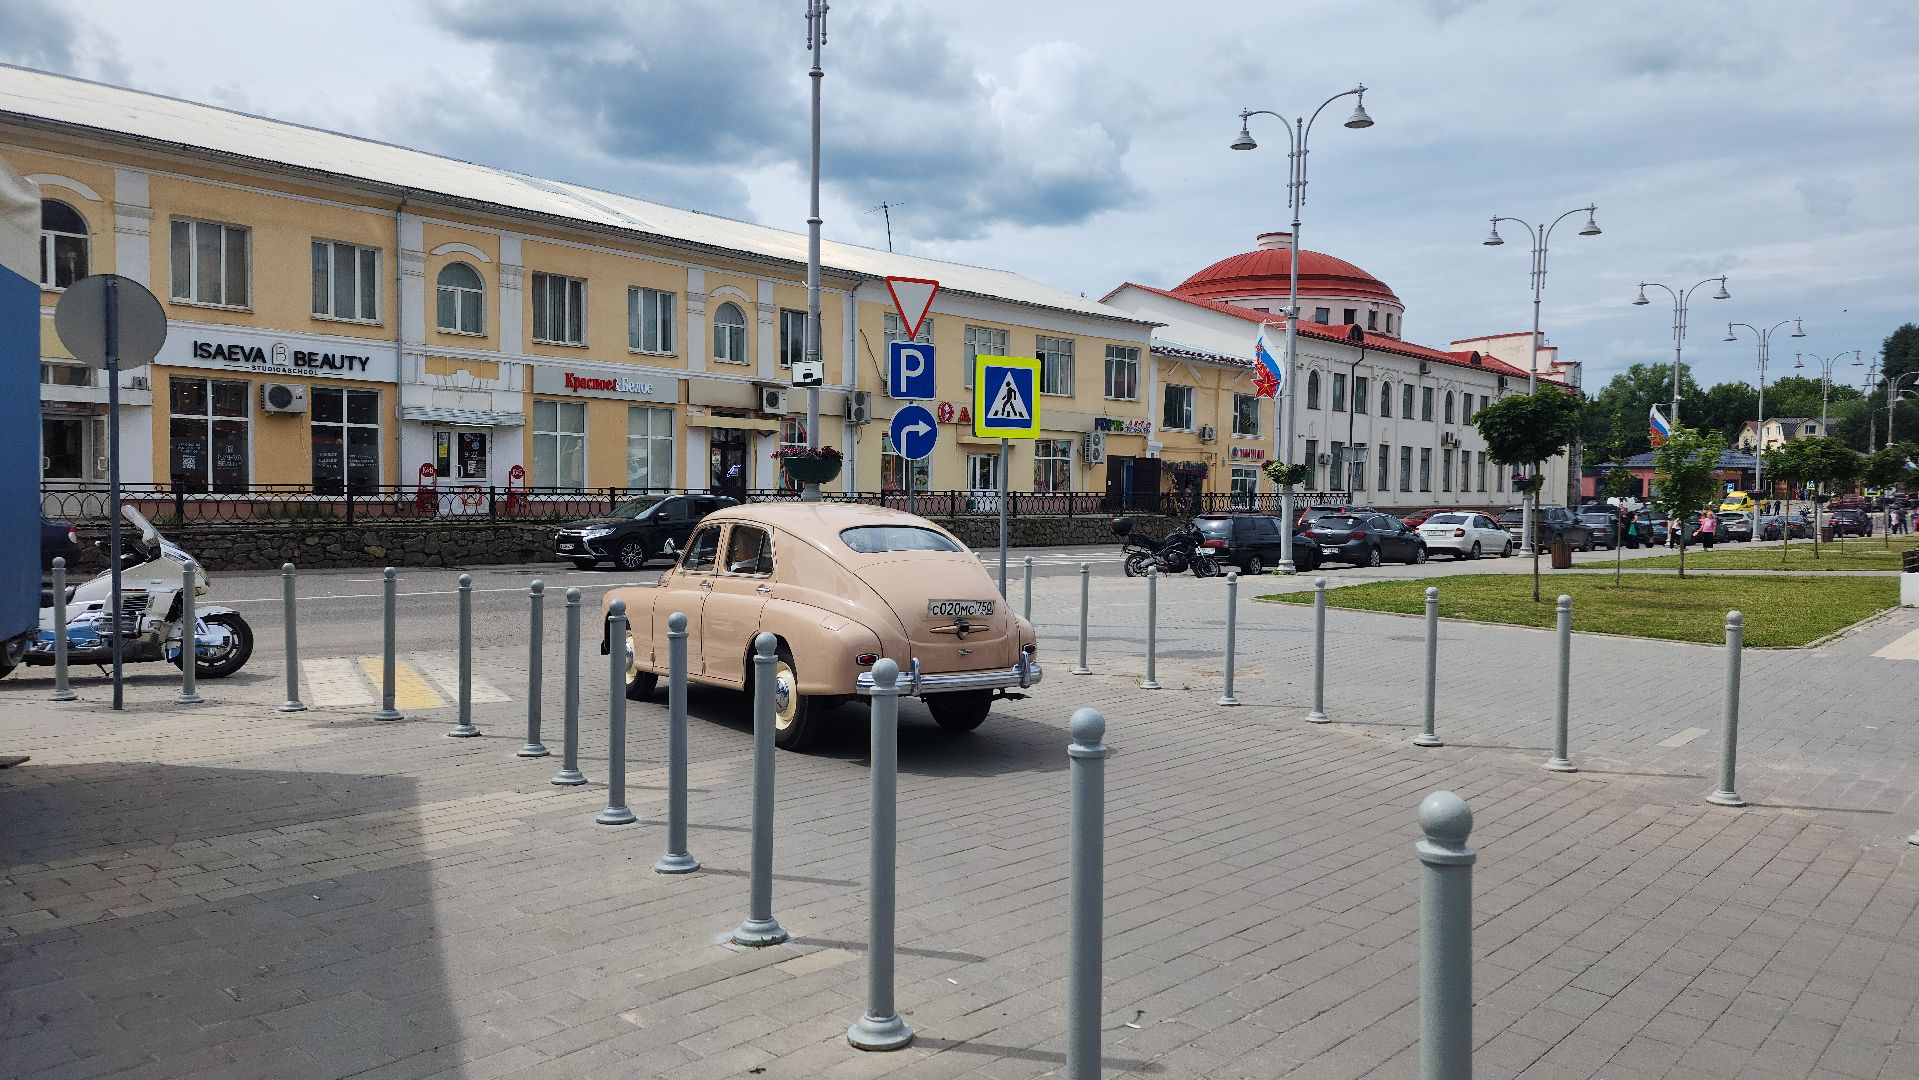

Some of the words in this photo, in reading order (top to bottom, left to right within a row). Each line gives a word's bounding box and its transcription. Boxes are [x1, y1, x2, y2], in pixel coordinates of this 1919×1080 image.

[193, 340, 267, 363] ISAEVA
[294, 350, 370, 371] BEAUTY
[251, 364, 319, 376] STUDIO&SCHOOL
[900, 348, 925, 393] P
